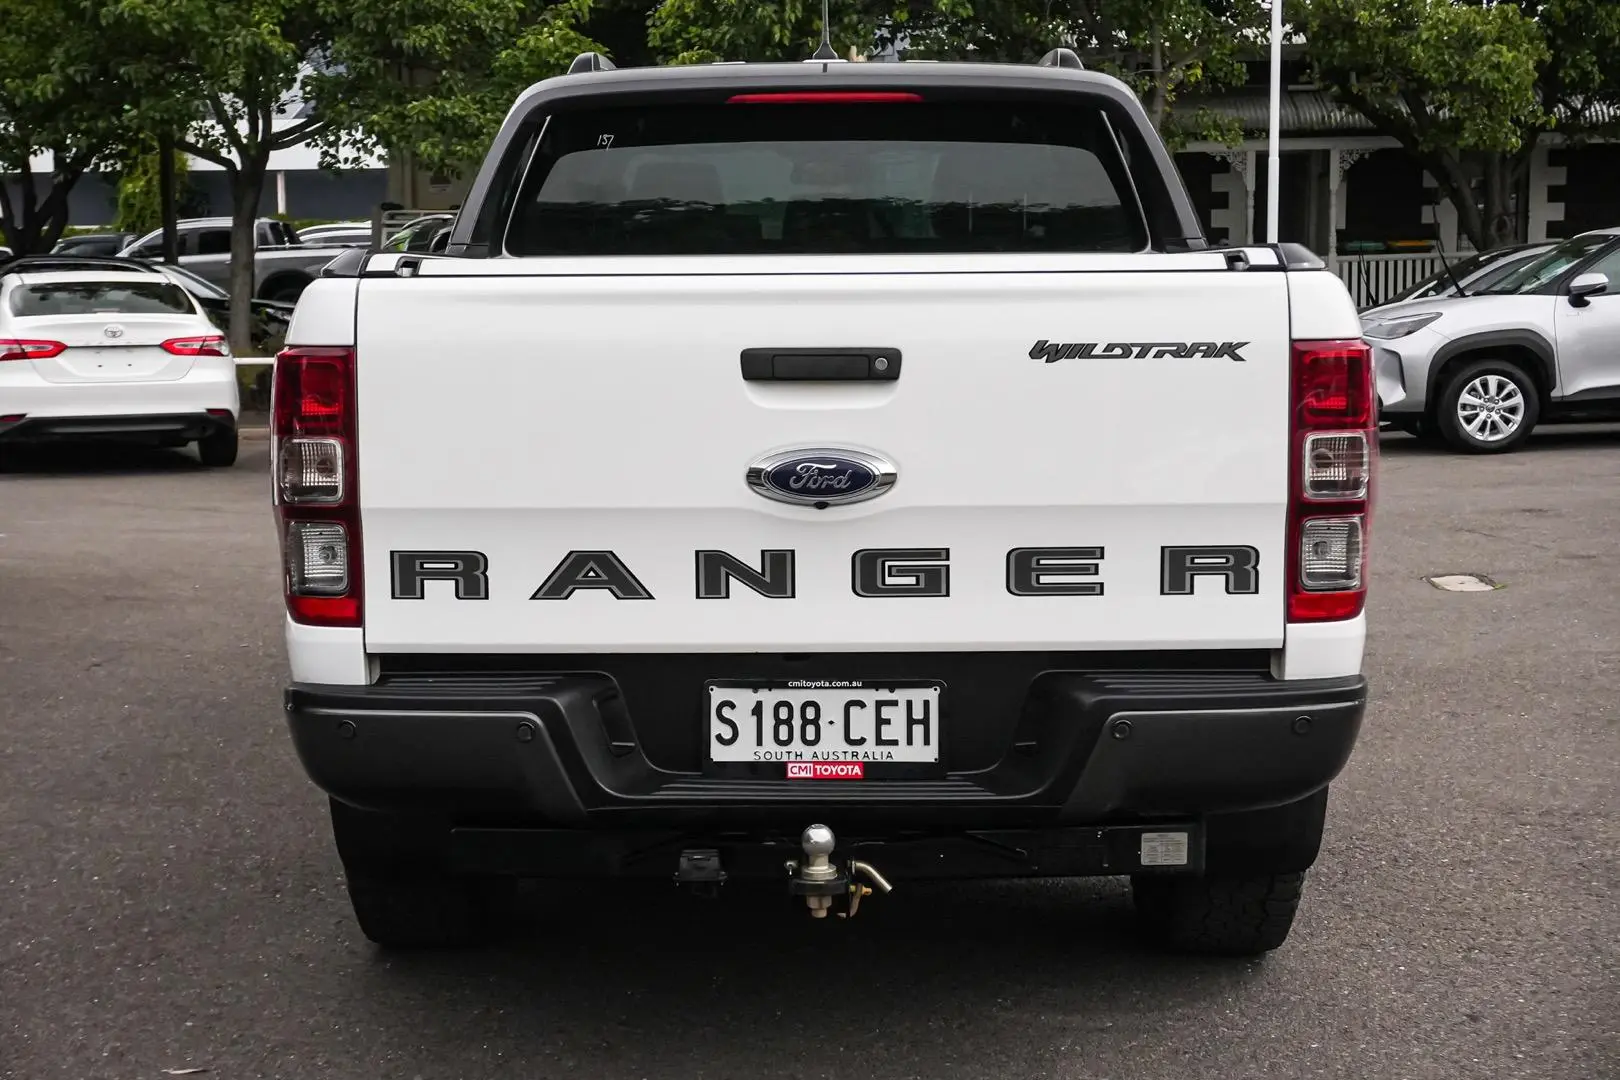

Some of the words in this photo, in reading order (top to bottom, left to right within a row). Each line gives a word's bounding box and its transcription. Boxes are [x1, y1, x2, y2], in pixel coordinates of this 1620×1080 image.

[1028, 339, 1251, 363] WILDTRAK
[789, 462, 853, 489] Ford
[389, 545, 1261, 601] RANGER
[788, 679, 863, 689] cmitoyota.com.au
[753, 751, 804, 761] SOUTH
[811, 751, 894, 761] AUSTRALIA
[789, 764, 812, 777] CMI
[815, 764, 862, 776] TOYOTA
